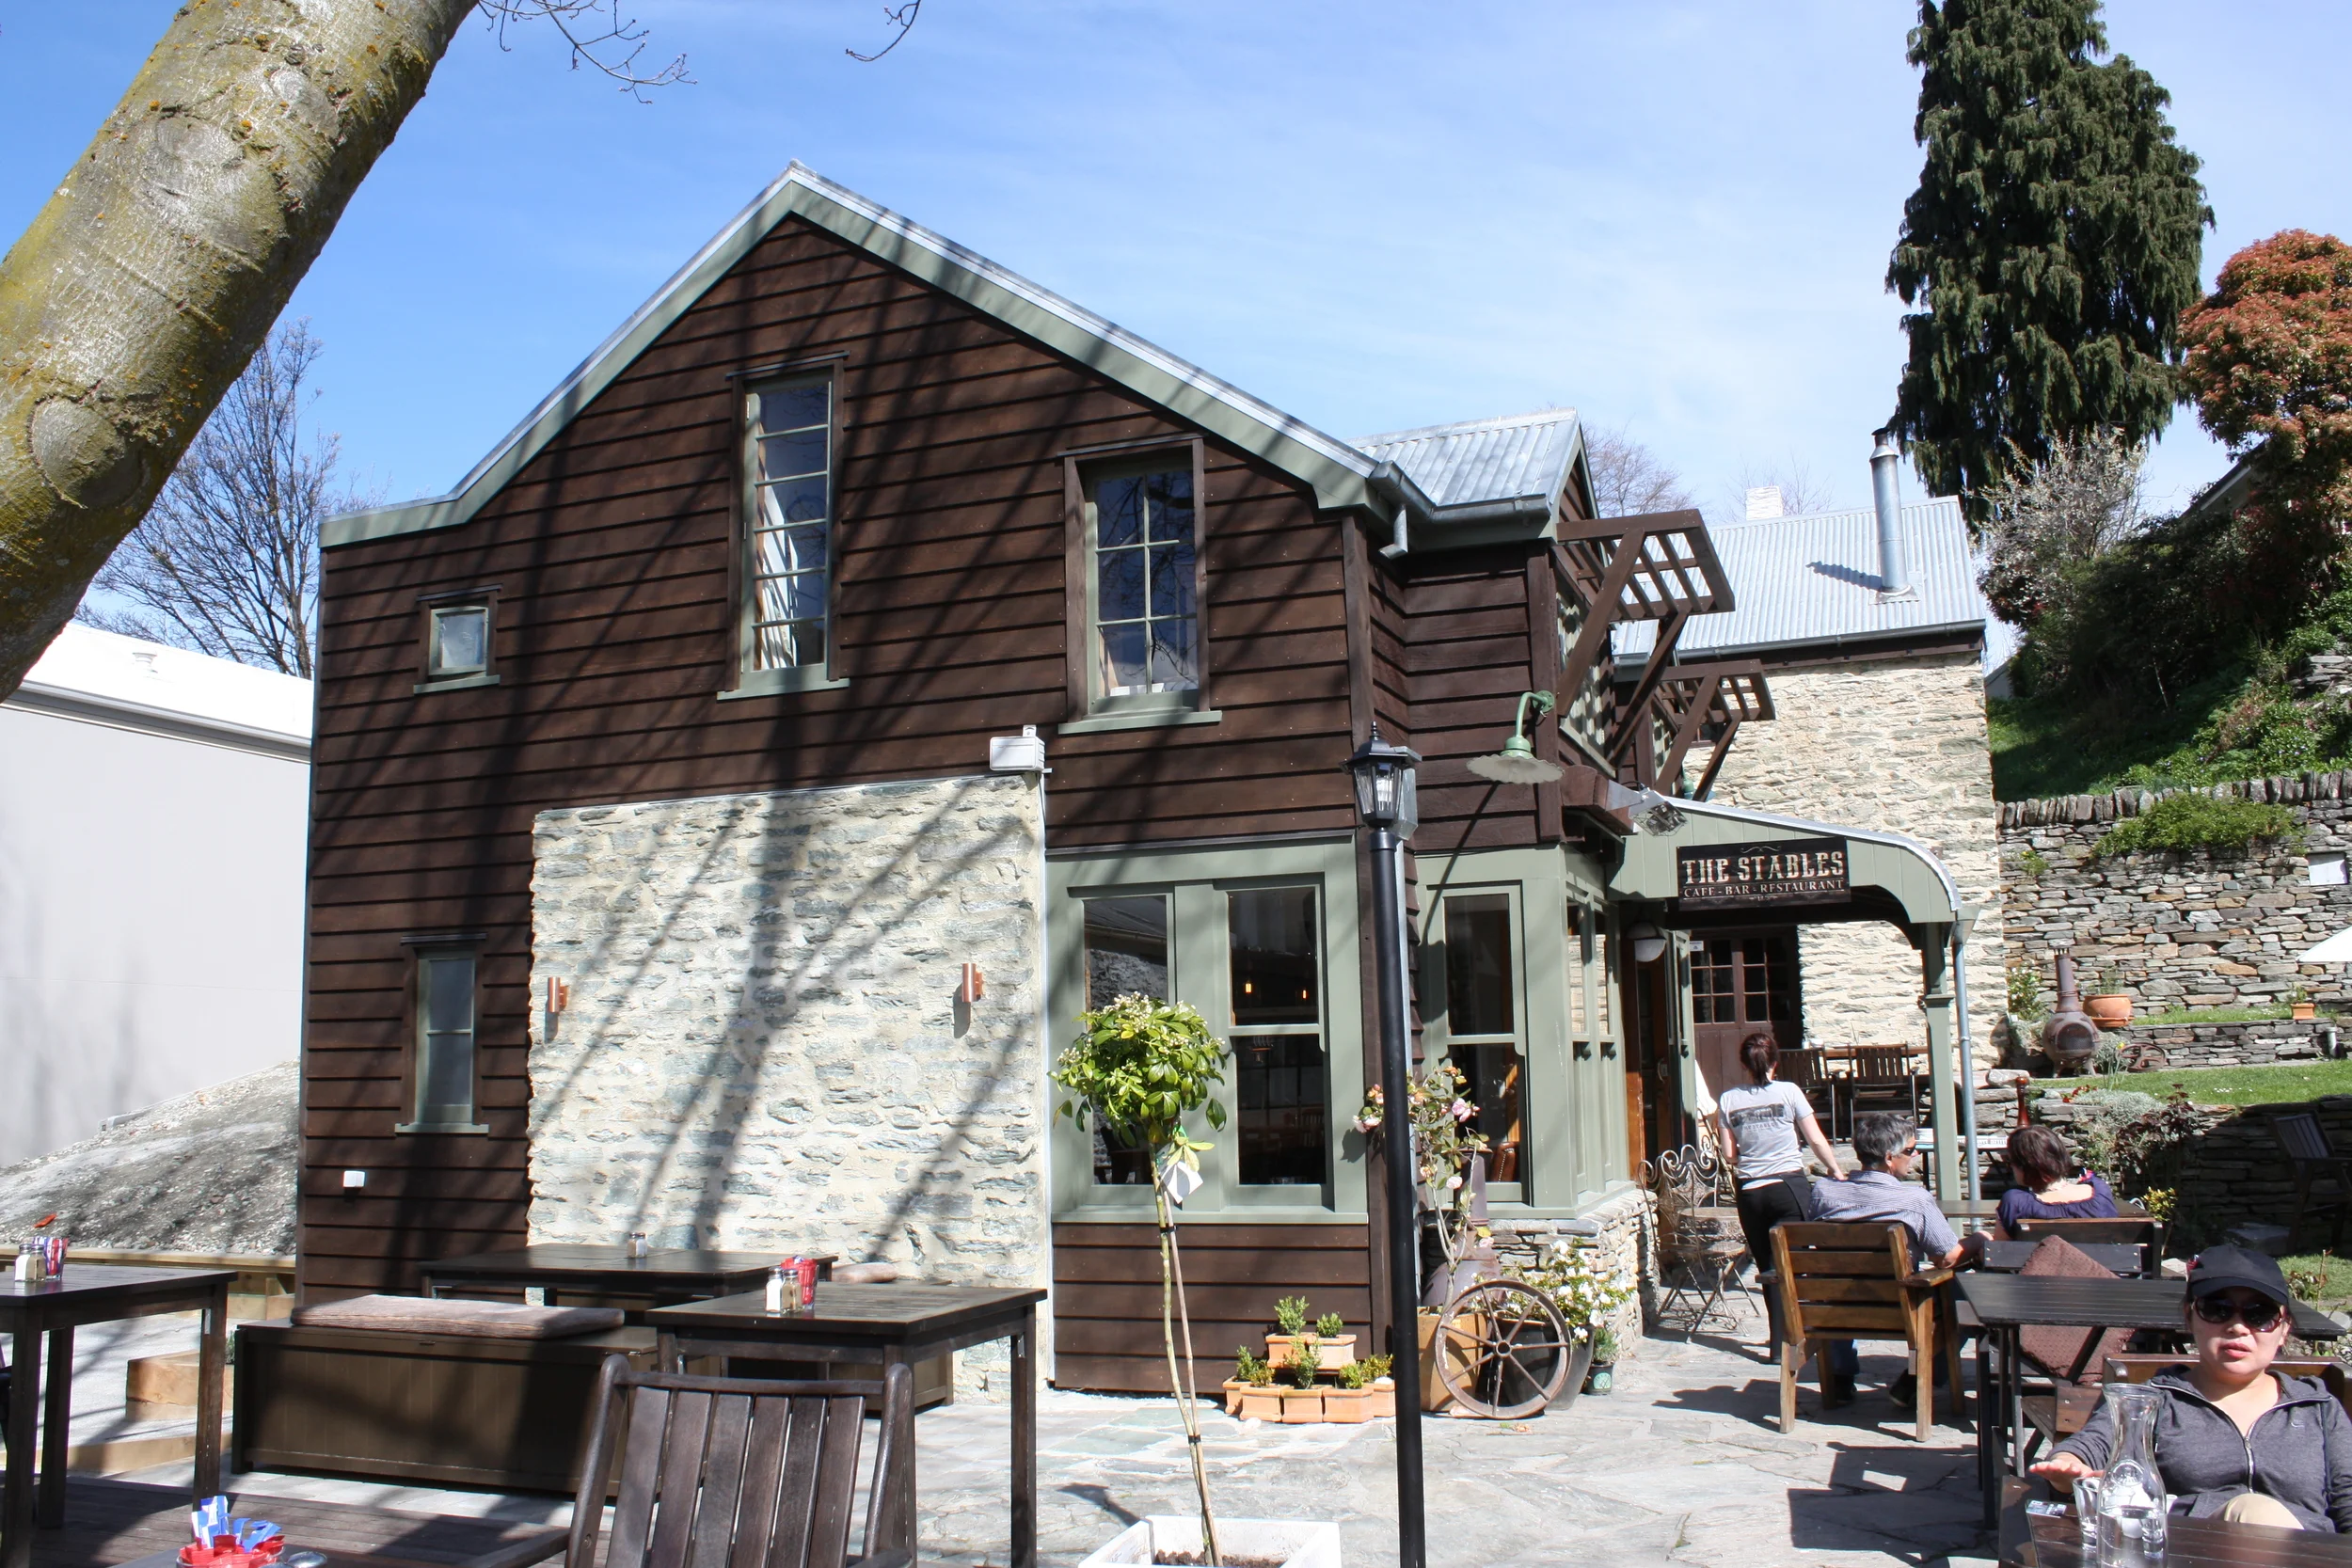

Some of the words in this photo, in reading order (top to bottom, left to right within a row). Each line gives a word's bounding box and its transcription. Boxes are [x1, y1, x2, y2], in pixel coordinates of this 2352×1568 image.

[1682, 858, 1730, 884] THE
[1738, 851, 1844, 881] STABLES
[1684, 887, 1716, 897] CAFE
[1725, 884, 1750, 895] BAR
[1760, 879, 1844, 894] RESTAURANT
